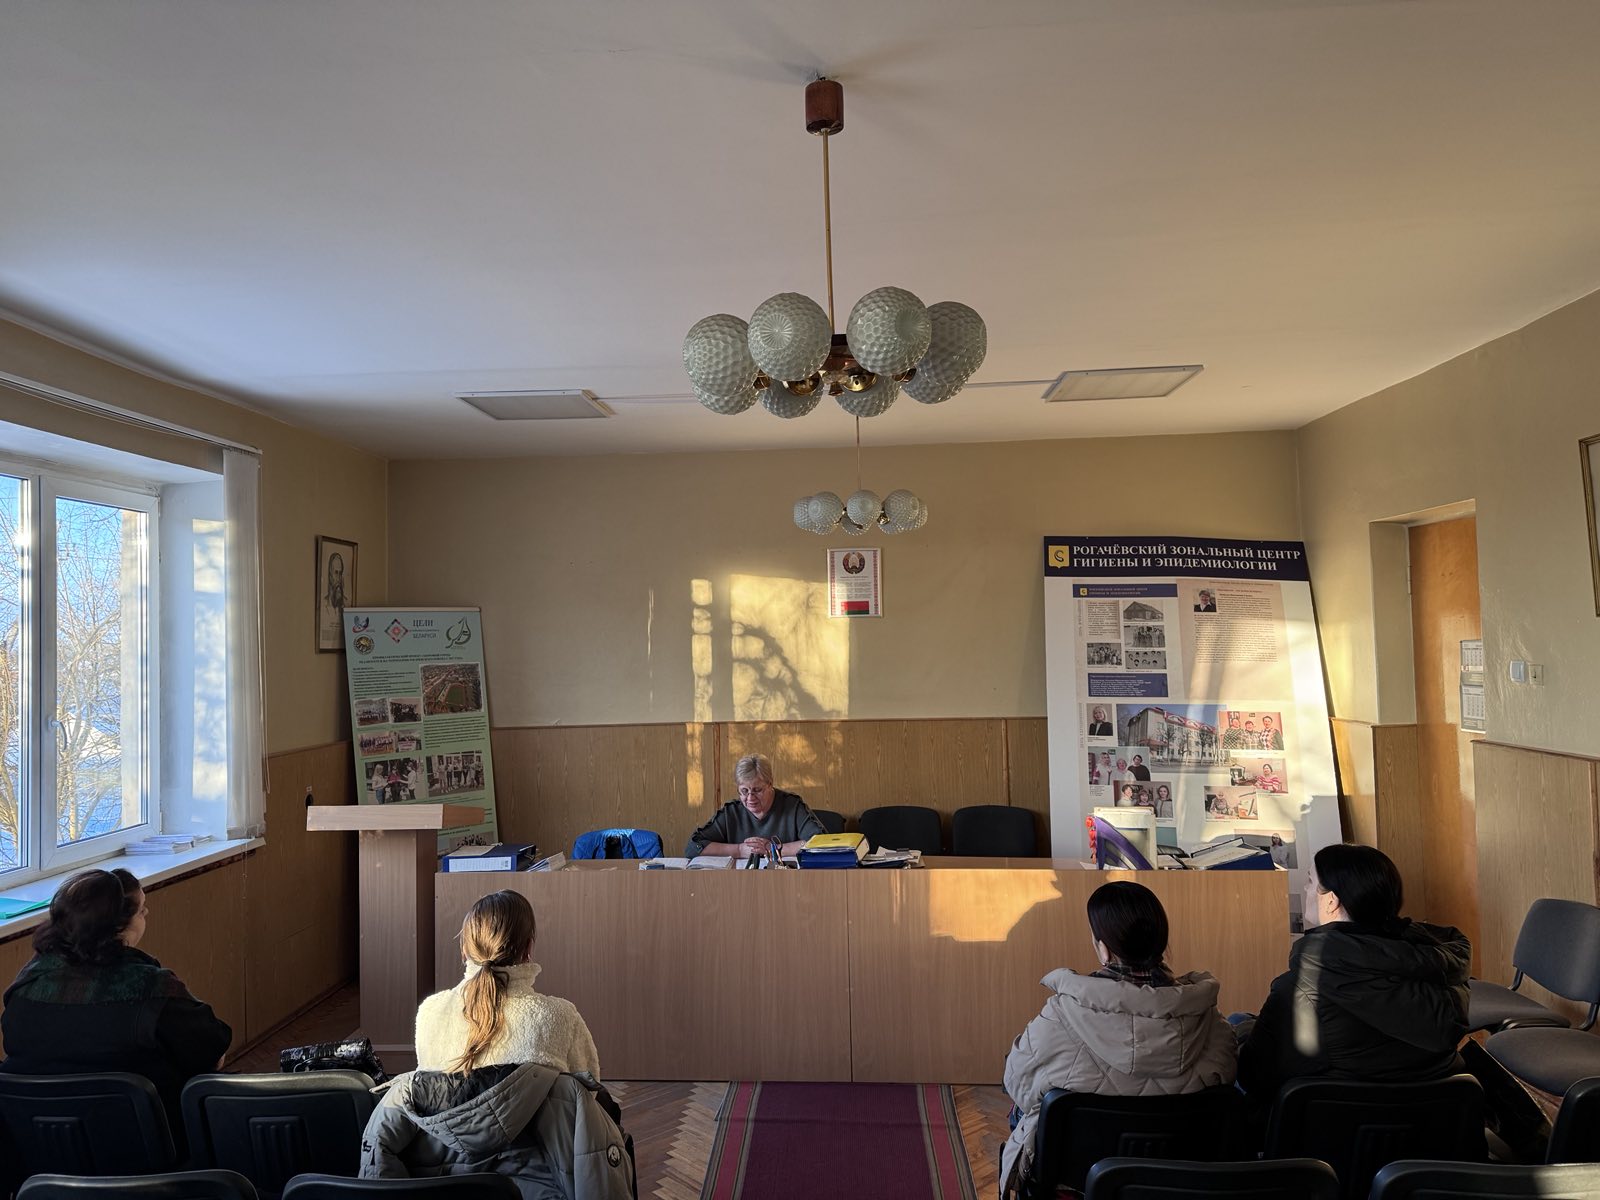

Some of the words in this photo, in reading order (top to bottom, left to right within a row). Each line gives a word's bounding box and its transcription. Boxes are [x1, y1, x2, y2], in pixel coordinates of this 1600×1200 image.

[1073, 543, 1167, 555] РОГАЧЁВСКИЙ
[1169, 545, 1254, 558] ЗОНАЛЬНЫЙ
[1257, 549, 1301, 560] ЦЕНТР
[1073, 557, 1138, 567] ГИГИЕНЫ
[1142, 557, 1152, 567] И
[1155, 557, 1277, 571] ЭПИДЕМИОЛОГИИ
[412, 619, 433, 627] ЦЕЛИ
